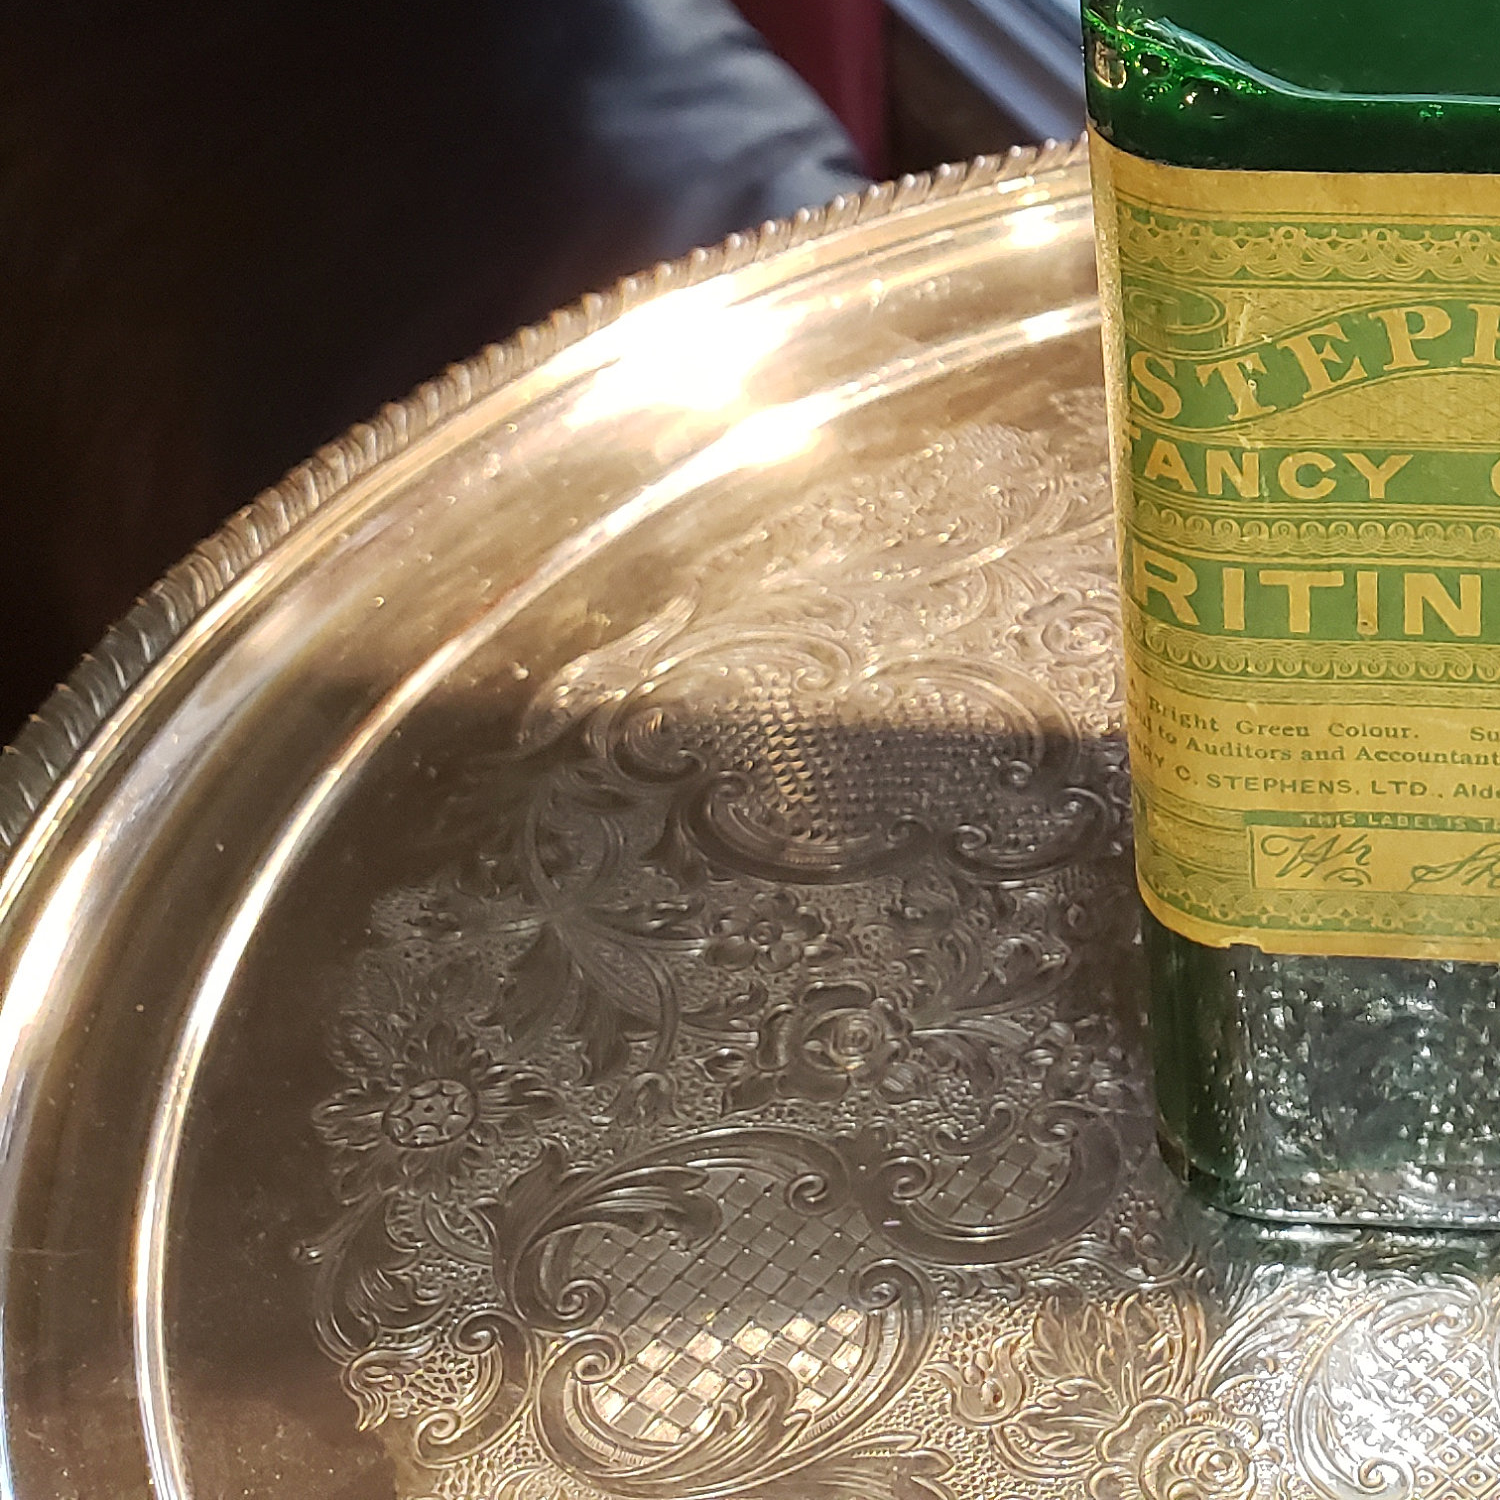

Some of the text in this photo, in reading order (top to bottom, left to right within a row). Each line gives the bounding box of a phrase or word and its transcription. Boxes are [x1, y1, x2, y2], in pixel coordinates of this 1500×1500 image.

[1149, 696, 1219, 732] Bright
[1236, 719, 1309, 737] Green
[1328, 722, 1418, 739] Colour.
[1158, 725, 1177, 745] to
[1186, 738, 1291, 761] Auditors
[1301, 746, 1345, 762] and
[1175, 764, 1198, 785] C.
[1301, 813, 1356, 827] THIS
[1368, 814, 1438, 828] LABEL
[1447, 817, 1467, 830] IS
